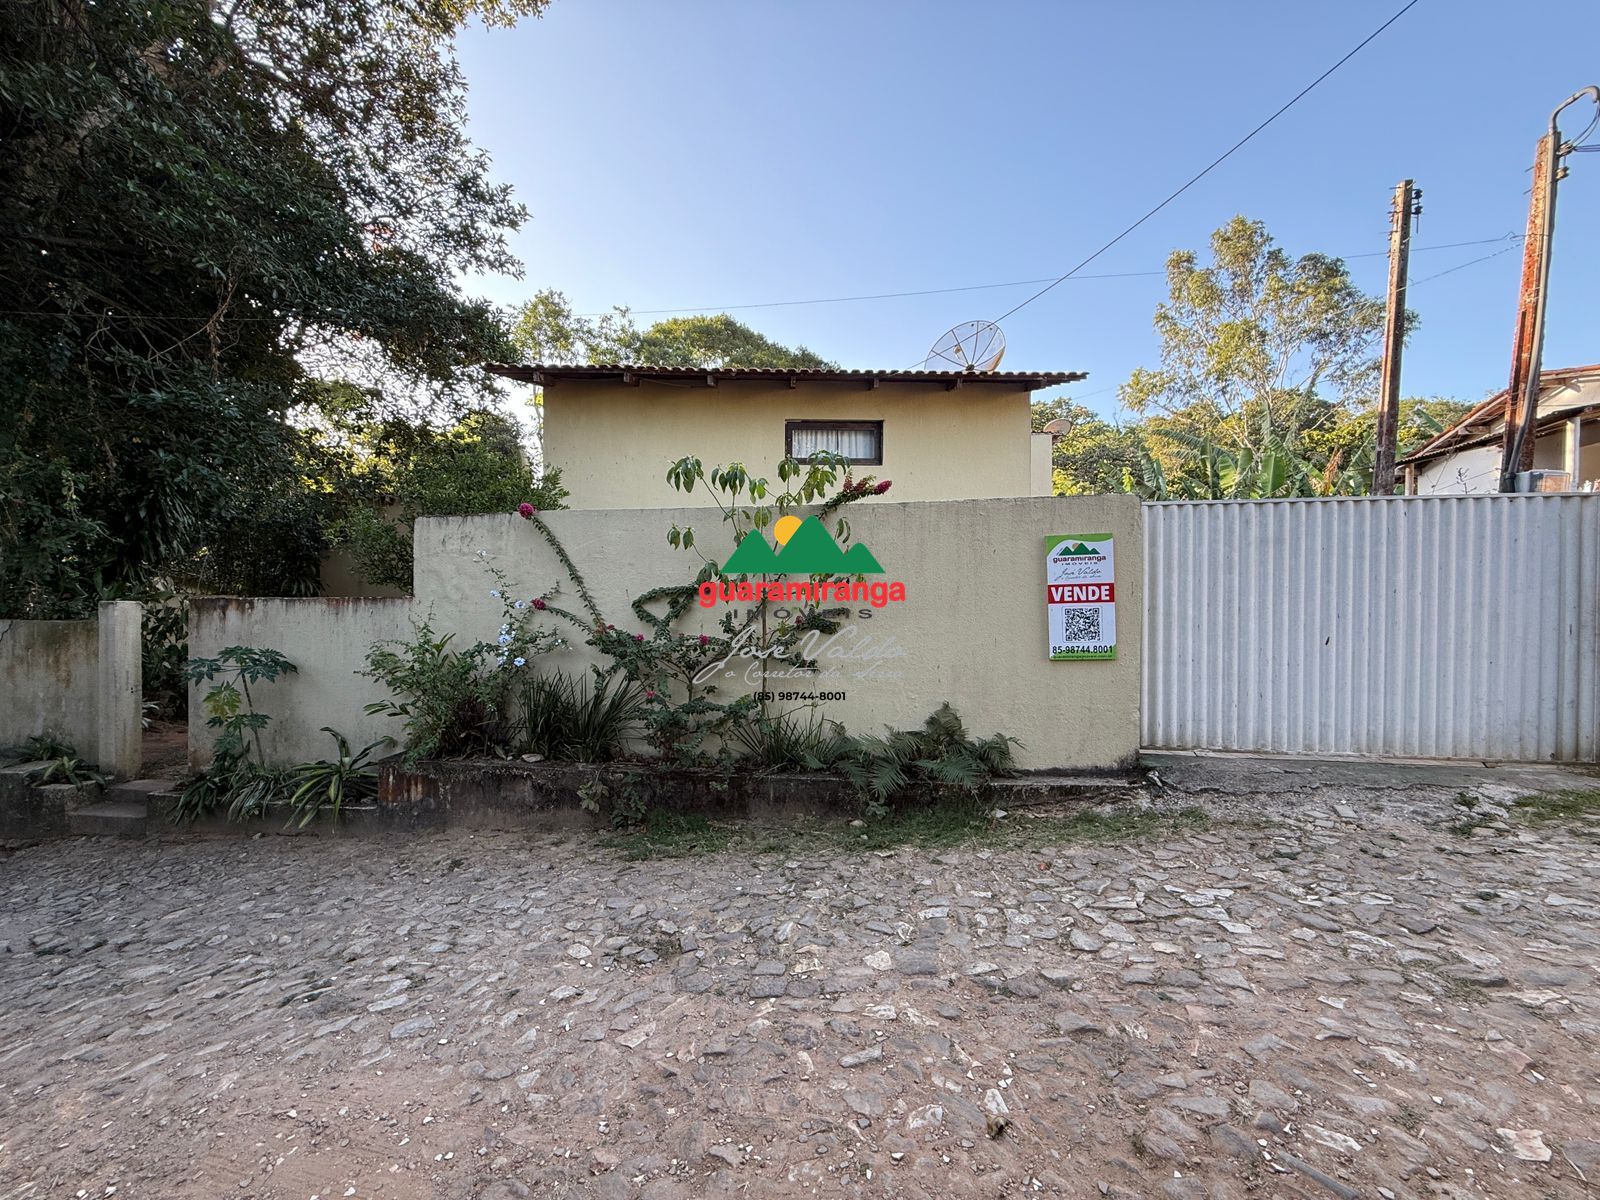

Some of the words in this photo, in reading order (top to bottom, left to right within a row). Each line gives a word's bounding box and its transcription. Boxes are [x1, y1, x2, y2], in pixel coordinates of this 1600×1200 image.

[1053, 555, 1107, 563] guaramiranga
[1050, 585, 1110, 602] VENDE
[1052, 645, 1113, 654] 85-98744.8001
